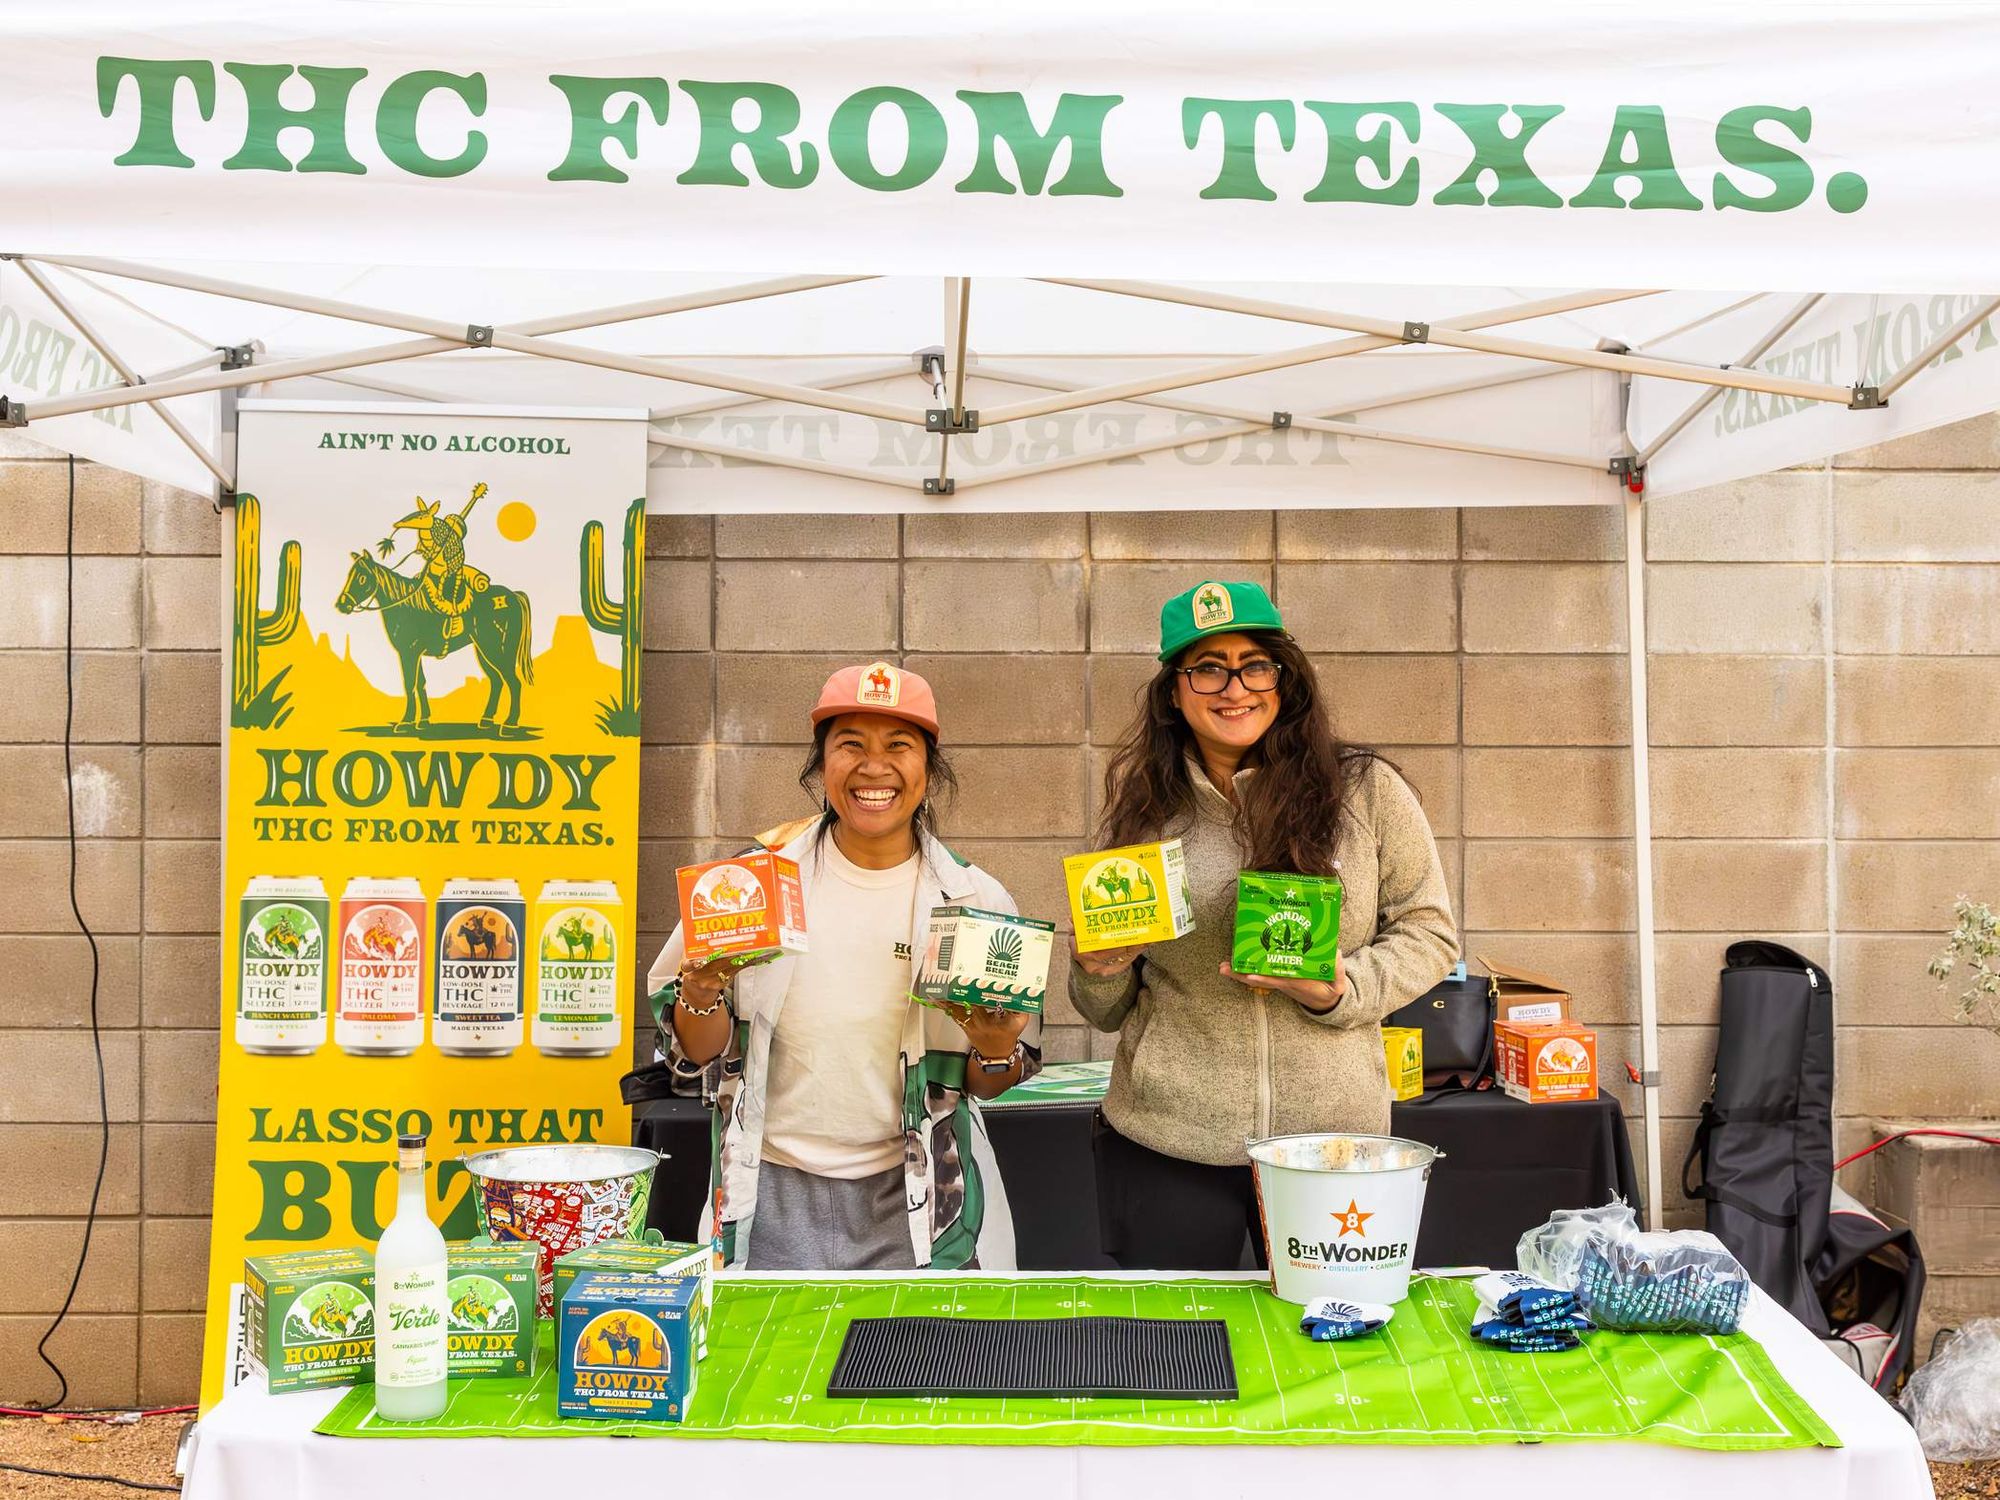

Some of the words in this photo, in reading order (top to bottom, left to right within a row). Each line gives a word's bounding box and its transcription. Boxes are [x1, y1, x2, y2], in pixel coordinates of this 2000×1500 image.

[96, 55, 489, 179] THC
[547, 74, 1125, 198] FROM
[1181, 96, 1869, 214] TEXAS.
[318, 432, 394, 451] AIN'T
[401, 433, 437, 452] NO
[444, 435, 571, 455] ALCOHOL
[254, 748, 617, 811] HOWDY
[254, 816, 332, 841] THC
[345, 818, 460, 845] FROM
[472, 820, 615, 847] TEXAS.
[693, 910, 767, 935] HOWDY
[1084, 904, 1158, 928] HOWDY
[1264, 911, 1312, 930] WONDER
[986, 959, 1020, 970] BEACH
[1266, 954, 1304, 966] WATER
[245, 962, 320, 977] HOWDY
[344, 964, 417, 979] HOWDY
[442, 964, 516, 980] HOWDY
[541, 965, 614, 980] HOWDY
[985, 965, 1018, 978] BREAK
[247, 986, 286, 1000] THC
[345, 987, 383, 1001] THC
[443, 988, 484, 1002] THC
[543, 989, 582, 1003] THC
[360, 1013, 398, 1021] PALOMA
[553, 1014, 599, 1022] LEMONADE
[1517, 1006, 1552, 1017] HOWDY
[1537, 1073, 1590, 1087] HOWDY
[248, 1107, 433, 1143] LASSO
[448, 1108, 604, 1144] THAT
[1346, 1213, 1359, 1228] 8
[1318, 1242, 1408, 1263] WONDER
[1289, 1259, 1322, 1271] BREWERY
[1328, 1264, 1369, 1273] DISTILLERY
[389, 1307, 441, 1331] Verde
[447, 1334, 518, 1351] OWDY
[283, 1339, 376, 1365] HOWDY
[448, 1350, 479, 1359] FROM
[480, 1350, 518, 1358] TEXAS.
[283, 1363, 305, 1373] THC
[306, 1360, 337, 1371] FROM
[573, 1371, 670, 1392] HOWDY
[573, 1388, 596, 1397] THC
[597, 1389, 629, 1398] FROM
[630, 1390, 669, 1400] TEXAS.
[782, 1394, 813, 1405] 30
[1334, 1393, 1362, 1406] 30
